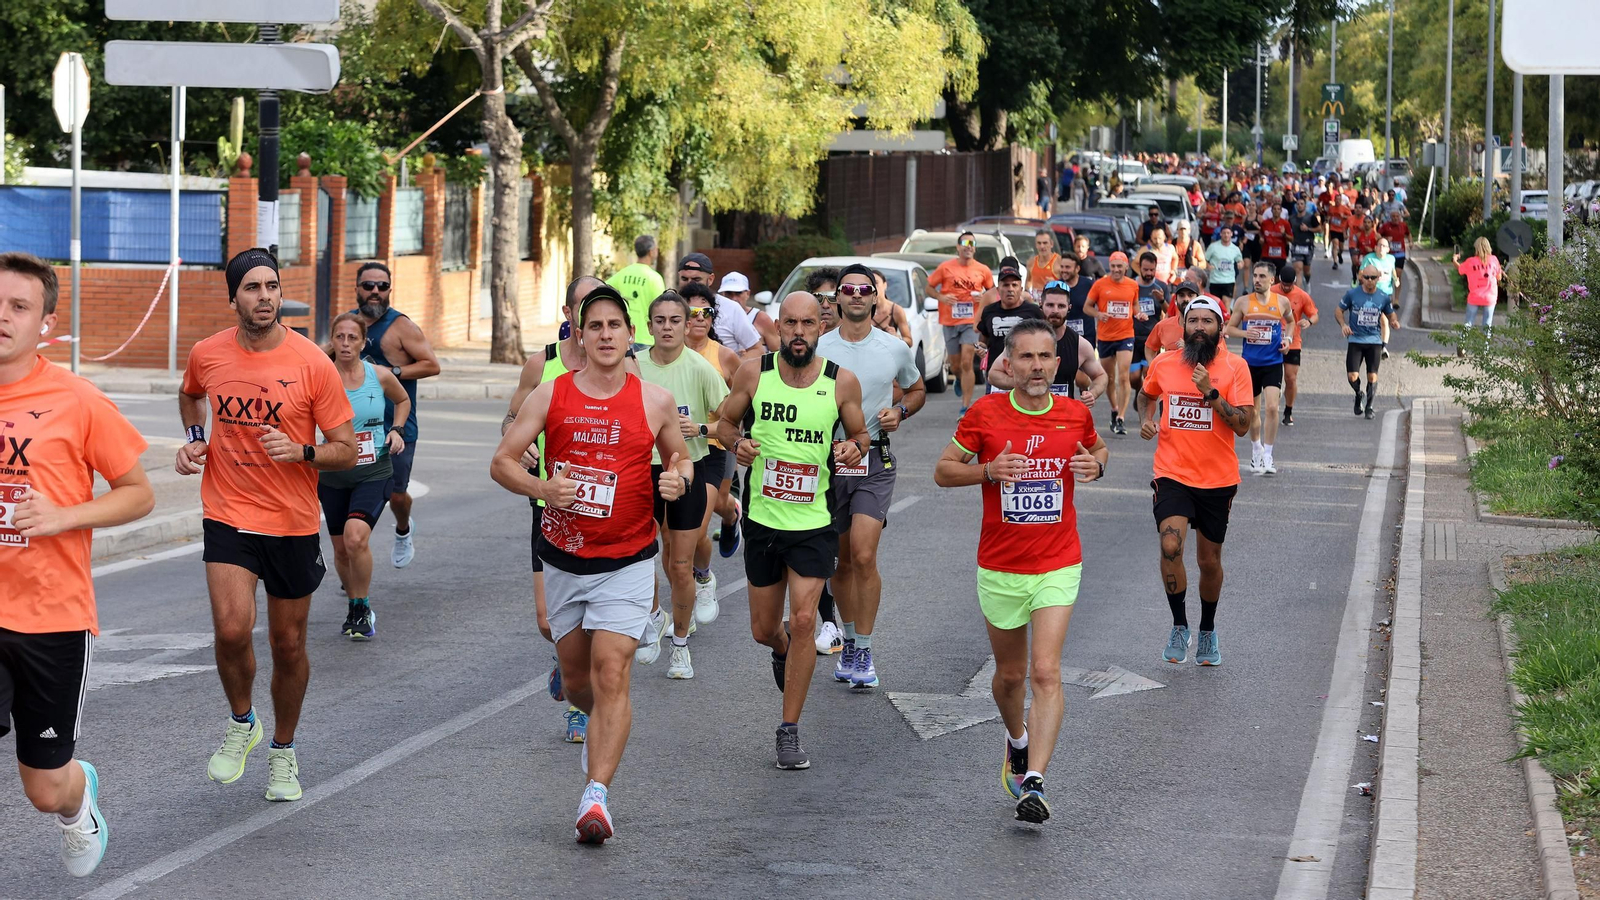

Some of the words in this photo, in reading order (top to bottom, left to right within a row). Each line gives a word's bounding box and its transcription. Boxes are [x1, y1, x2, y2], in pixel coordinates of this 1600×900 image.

[623, 275, 646, 287] STAFF
[761, 402, 797, 422] BRO
[1179, 407, 1202, 420] 460
[219, 417, 238, 425] MEDIA
[574, 416, 609, 425] GENERALI
[572, 430, 607, 444] MÁLAGA
[785, 428, 824, 444] TEAM
[775, 473, 803, 491] 551
[1012, 494, 1054, 510] 1068
